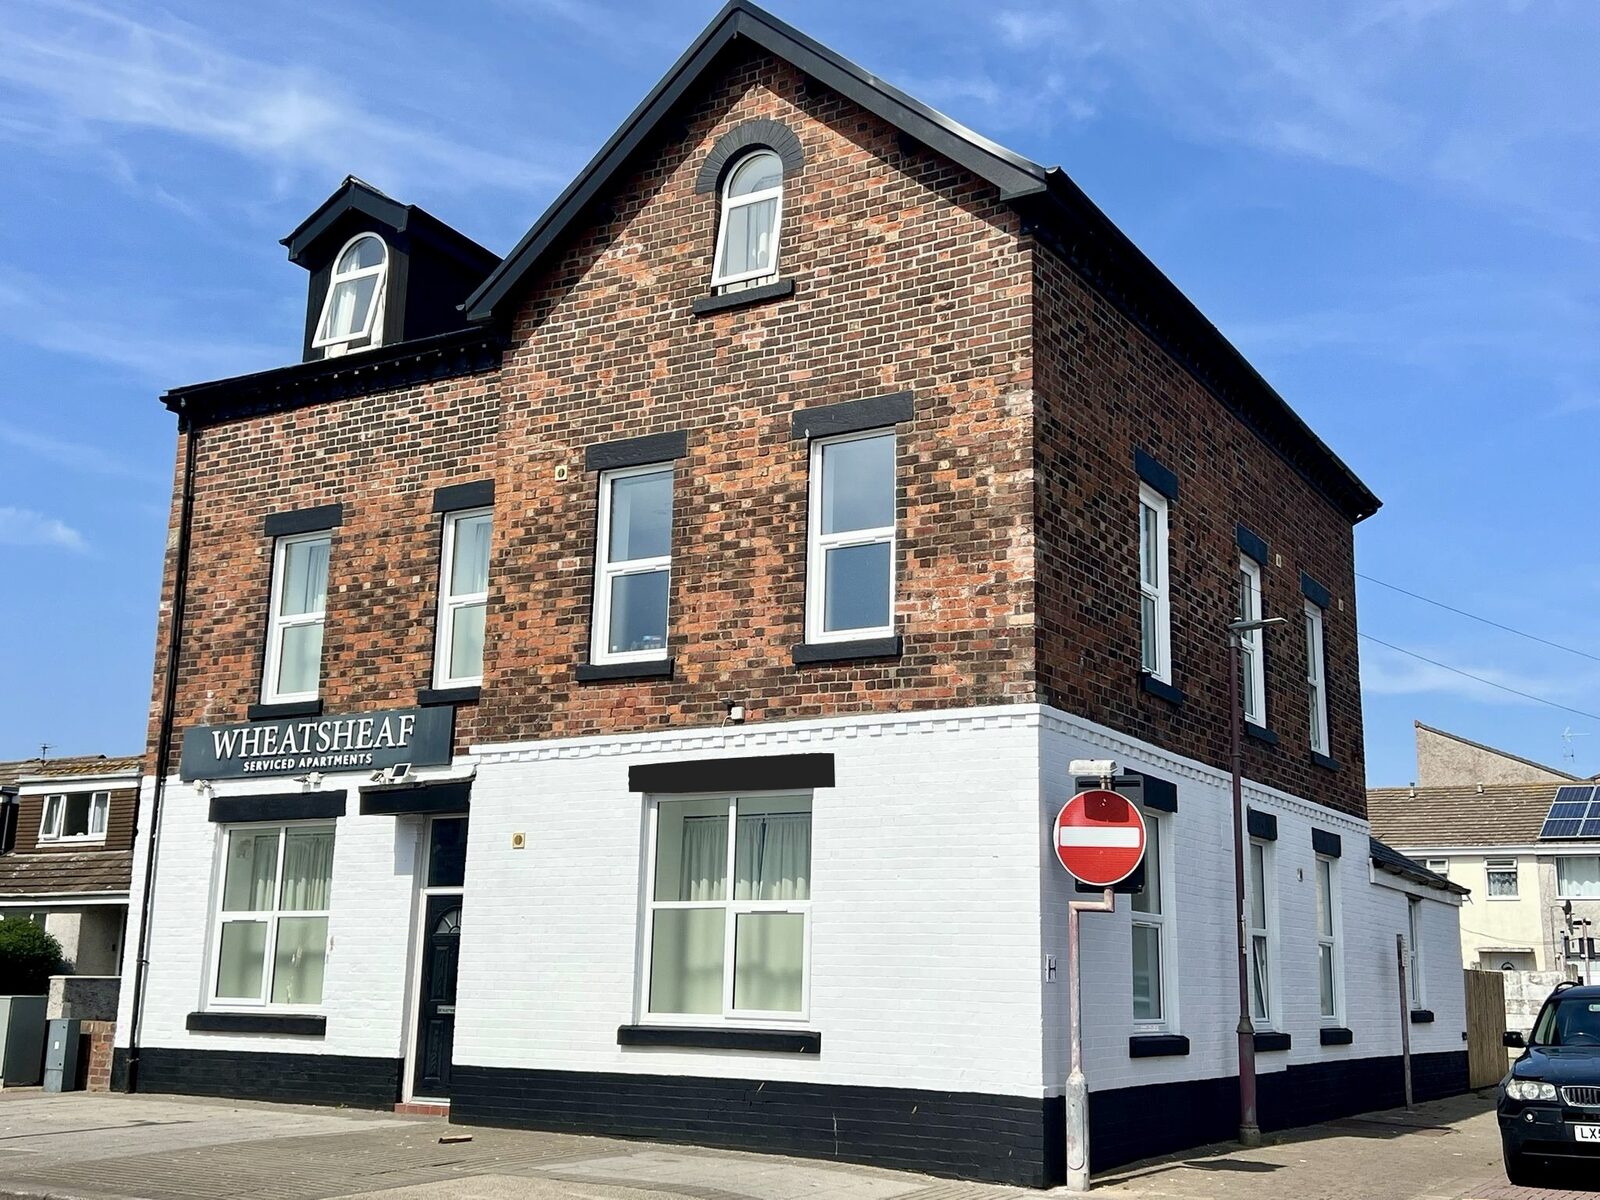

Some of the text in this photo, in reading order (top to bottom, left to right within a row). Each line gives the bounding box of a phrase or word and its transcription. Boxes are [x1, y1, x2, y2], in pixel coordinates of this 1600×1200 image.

[212, 715, 415, 760] WHEATSHEAF
[243, 753, 372, 772] SERVICED APARTMENTS
[1580, 1127, 1600, 1139] LX
